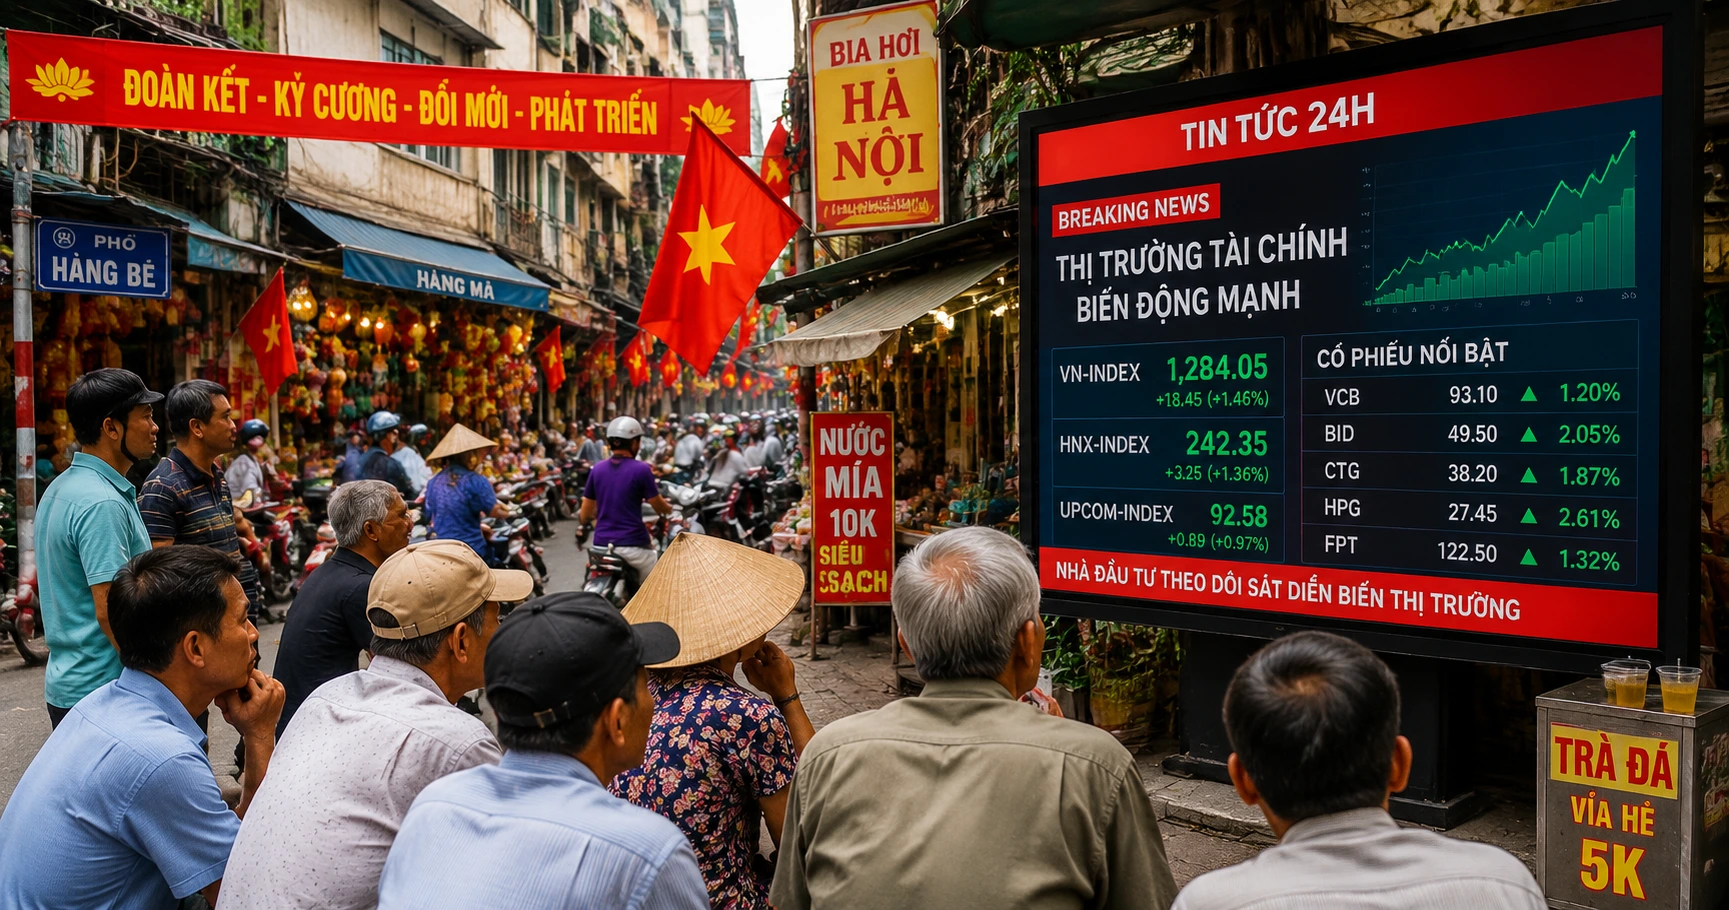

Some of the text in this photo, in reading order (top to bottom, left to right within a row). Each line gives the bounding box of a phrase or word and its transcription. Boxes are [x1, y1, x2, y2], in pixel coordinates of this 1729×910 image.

[830, 27, 920, 67] BIA HƠI
[123, 63, 194, 110] ĐOÀN
[203, 64, 249, 114] KẾT
[313, 81, 397, 123] CƯƠNG
[1180, 92, 1374, 151] TIN TỨC 24H
[832, 125, 924, 186] NỘI
[1058, 192, 1210, 230] BREAKING NEWS
[1055, 223, 1347, 285] THỊ TRƯỜNG TÀI CHÍNH
[1077, 279, 1300, 325] BIẾN ĐỘNG MẠNH
[1060, 353, 1268, 386] VN-INDEX 1,284.05
[1465, 337, 1509, 368] BẬT
[1156, 390, 1269, 409] +18.45 (+1.46%)
[1324, 382, 1621, 406] VCB 93.10 1.20%
[819, 421, 886, 457] NƯỚC
[1060, 430, 1268, 456] HNX-INDEX 242.35
[1325, 424, 1621, 444] BID 49.50 2.05%
[825, 460, 884, 499] MÍA
[1165, 464, 1269, 484] +3.25 (+1.36%)
[1324, 461, 1620, 486] CTG 38.20 1.87%
[829, 508, 877, 538] 10K
[1060, 501, 1268, 528] UPCOM-INDEX 92.58
[1324, 497, 1620, 529] HPG 27.45 2.61%
[1168, 532, 1269, 554] +0.89 (+0.97%)
[1325, 534, 1620, 572] FPT 122.50 1.32%
[1056, 558, 1090, 582] NHÀ
[1094, 558, 1128, 585] ĐẦU
[1133, 566, 1157, 587] TƯ
[1160, 570, 1207, 592] THEO
[1248, 573, 1282, 599] SÁT
[1338, 580, 1383, 609] BIẾN
[1390, 589, 1423, 617] THỊ
[1430, 591, 1520, 621] TRƯỜNG
[1554, 733, 1617, 782] TRÀ
[1626, 742, 1673, 790] ĐÁ
[1580, 838, 1647, 900] 5K
